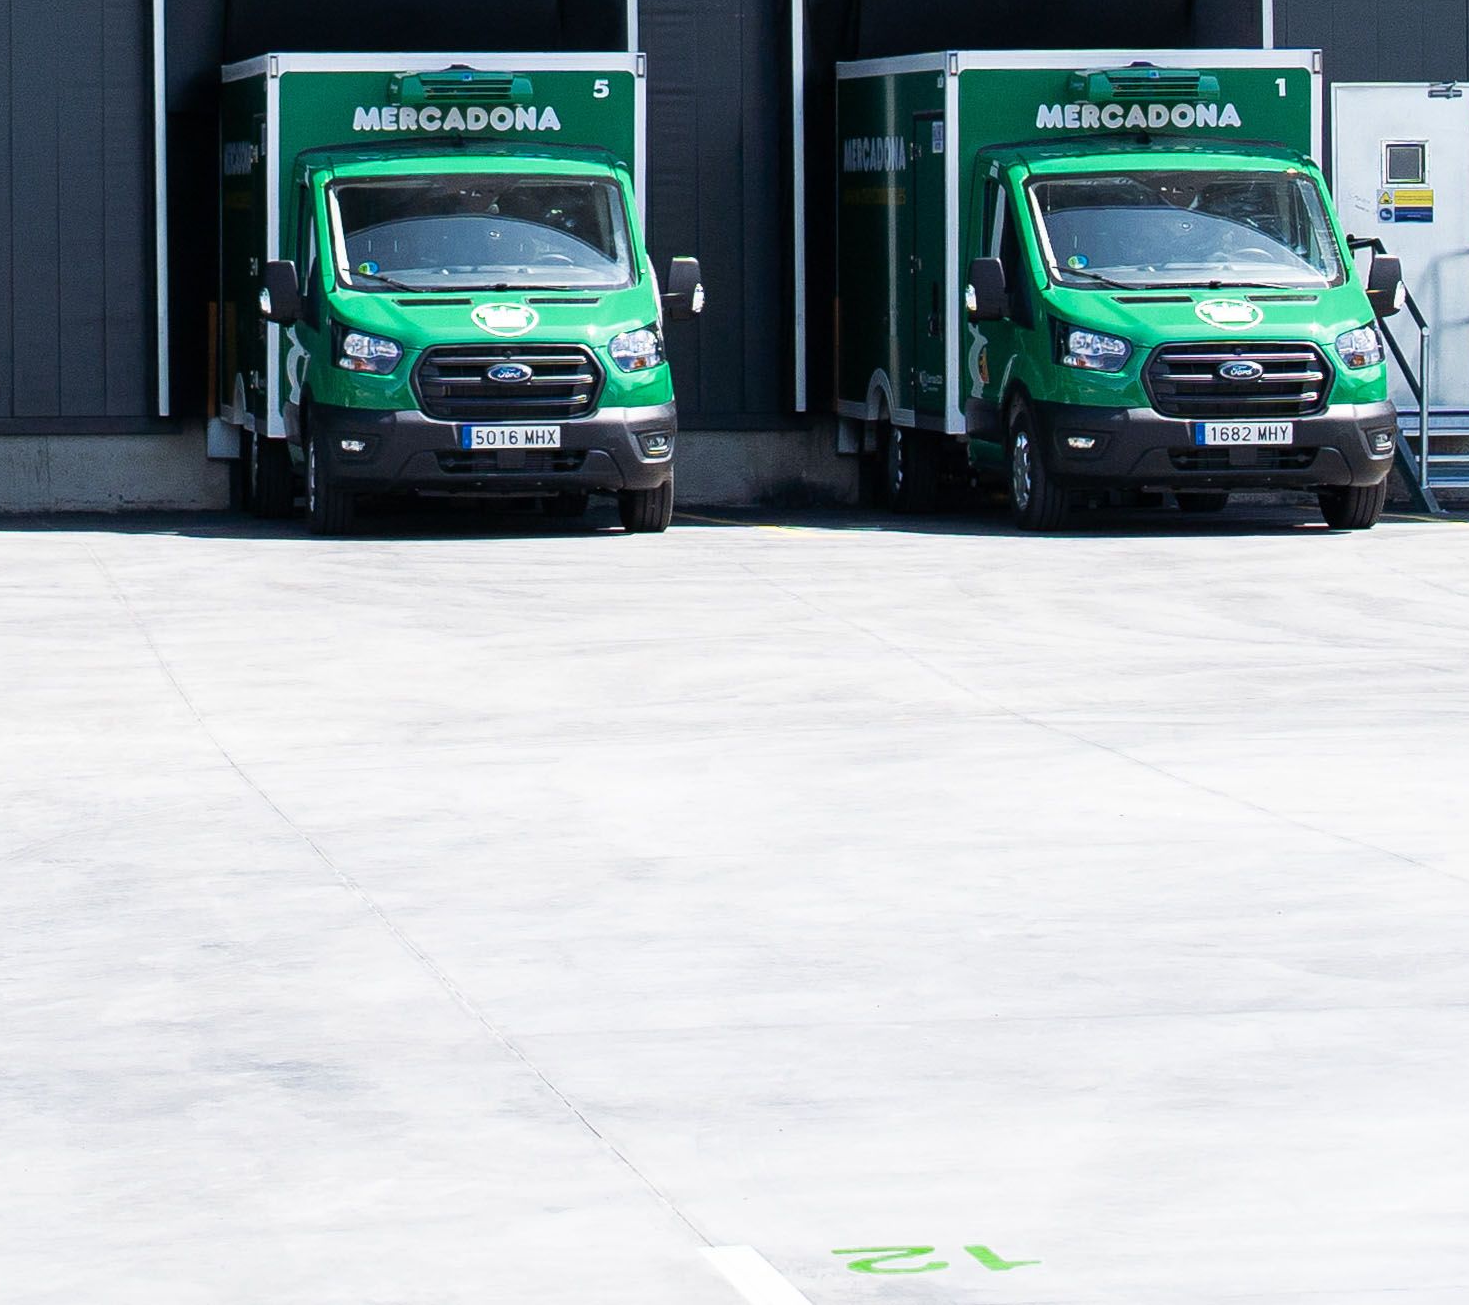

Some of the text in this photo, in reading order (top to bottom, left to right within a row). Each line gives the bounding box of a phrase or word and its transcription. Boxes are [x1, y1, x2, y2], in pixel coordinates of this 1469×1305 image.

[593, 79, 610, 99] 5
[1274, 78, 1286, 97] 1
[352, 106, 561, 131] MERCADONA
[1036, 103, 1242, 129] MERCADONA
[475, 429, 556, 446] 5016 MHX
[1211, 426, 1289, 442] 1682 MHY
